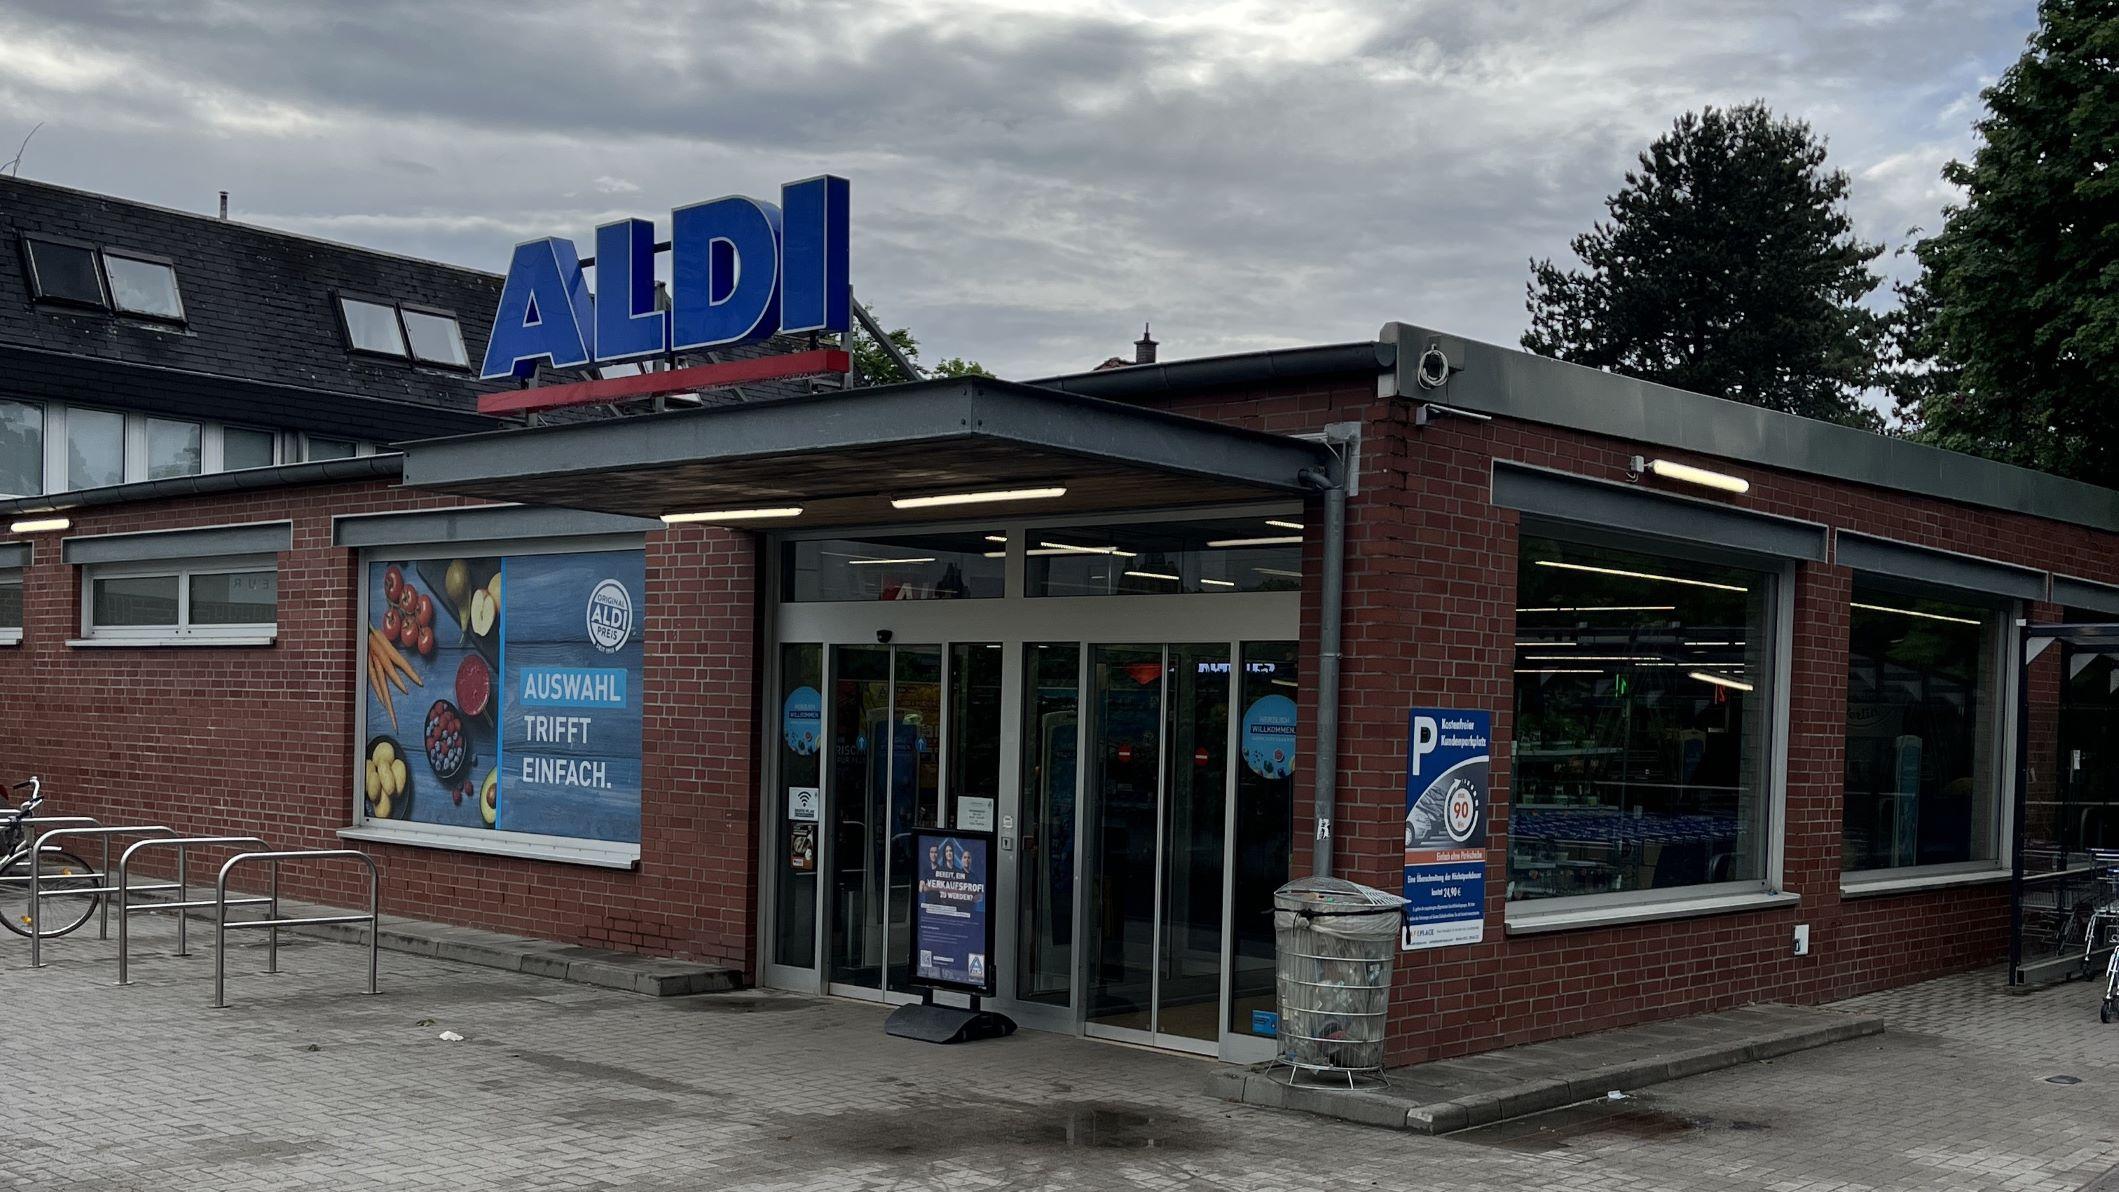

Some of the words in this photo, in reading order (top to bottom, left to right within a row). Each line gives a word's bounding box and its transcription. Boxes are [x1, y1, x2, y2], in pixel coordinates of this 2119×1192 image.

[480, 174, 850, 379] ALDI
[597, 594, 625, 608] ORIGINAL
[591, 604, 628, 630] ALDI
[597, 626, 618, 641] PREIS
[523, 673, 621, 701] AUSWAHL
[523, 715, 592, 744] TRIFFT
[1441, 718, 1474, 730] Kostenfreier
[1412, 716, 1438, 775] P
[1440, 734, 1487, 749] Kundenparkplatz
[522, 757, 612, 788] EINFACH.
[1453, 801, 1469, 819] 90
[935, 870, 956, 880] BEREIT,
[955, 872, 966, 880] EIN
[1407, 875, 1416, 884] Eine
[926, 879, 985, 893] VERKAUFSPROFI
[1443, 886, 1457, 899] 24,90
[939, 891, 947, 899] ZU
[947, 892, 974, 901] WERDEN?
